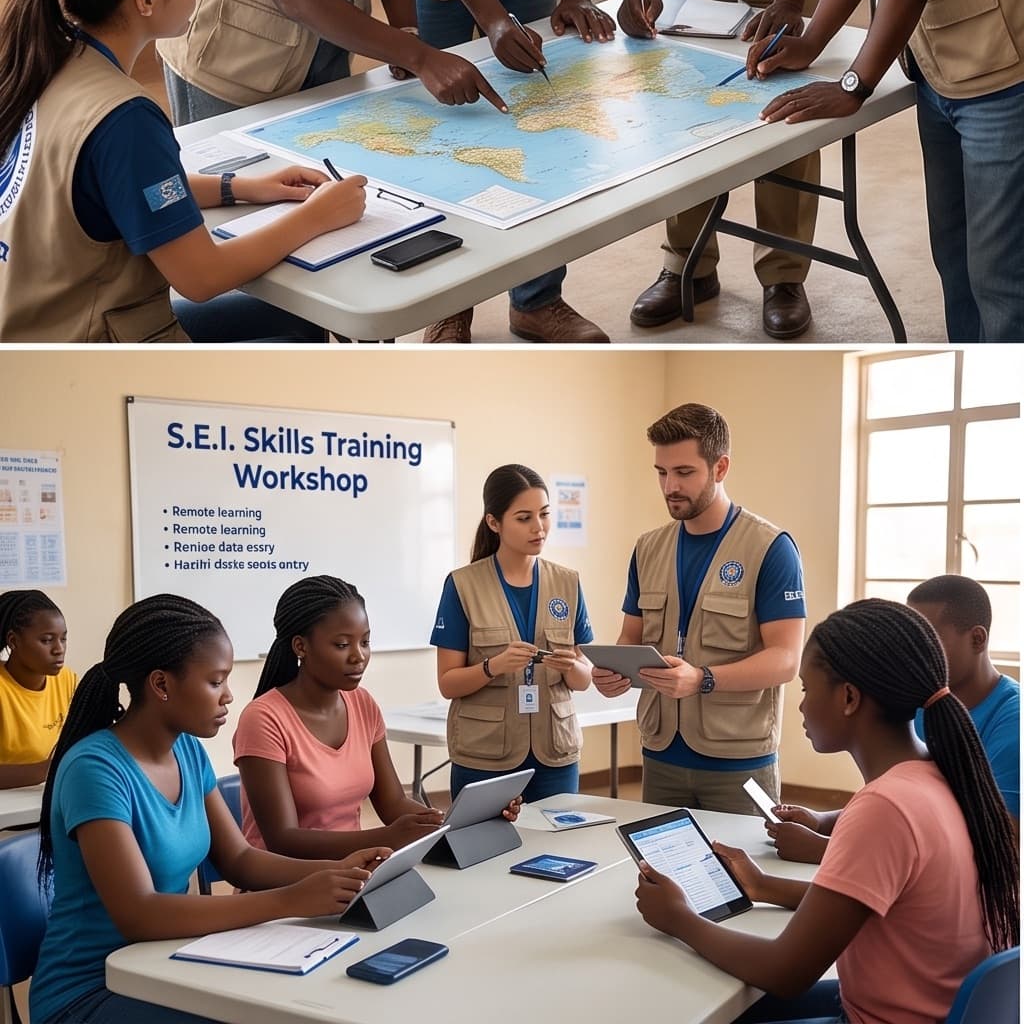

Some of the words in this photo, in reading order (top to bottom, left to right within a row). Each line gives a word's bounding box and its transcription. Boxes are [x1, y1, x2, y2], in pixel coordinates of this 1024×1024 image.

[167, 422, 235, 451] S.E.I.
[243, 426, 315, 455] Skills
[321, 431, 423, 466] Training
[233, 463, 368, 498] Workshop
[172, 506, 215, 517] Remote
[218, 507, 262, 521] learning
[173, 523, 217, 535] Remote
[220, 524, 266, 538] learning
[218, 541, 243, 552] data
